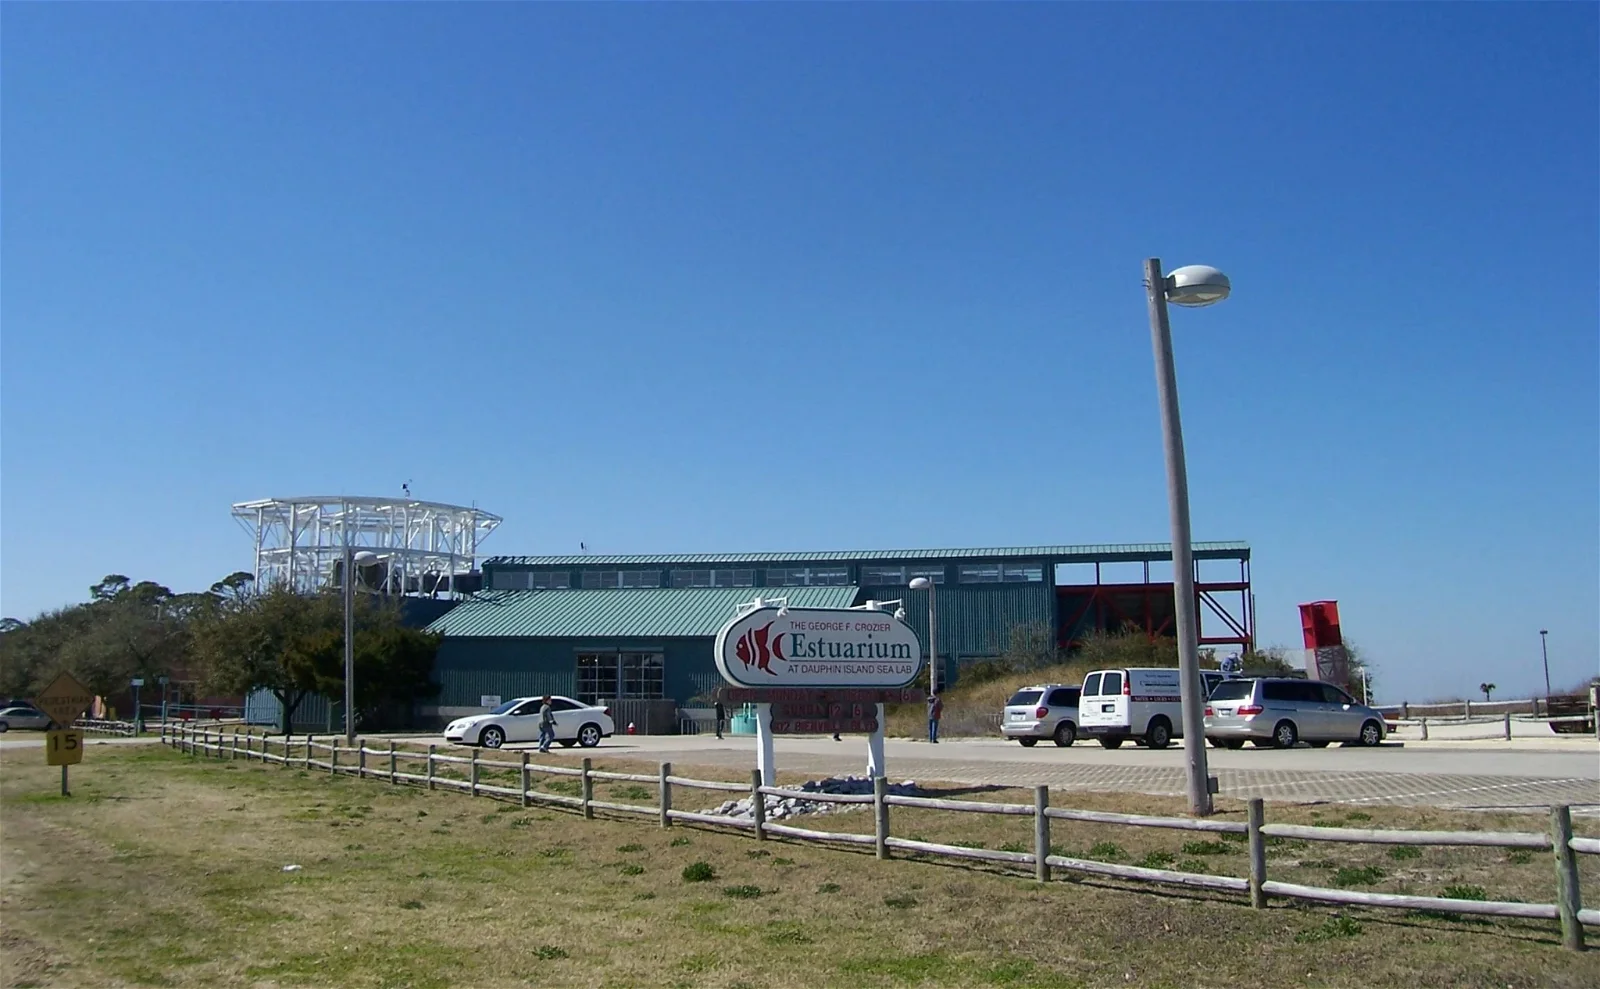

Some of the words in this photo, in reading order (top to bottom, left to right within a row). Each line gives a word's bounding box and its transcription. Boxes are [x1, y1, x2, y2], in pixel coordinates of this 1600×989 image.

[790, 621, 806, 630] THE
[808, 621, 843, 631] GEORGE
[845, 622, 853, 631] F.
[855, 623, 891, 632] CROZIER
[790, 633, 912, 659] Estuarium
[788, 664, 798, 673] AT
[801, 664, 841, 674] DAUPHIN
[843, 664, 875, 674] ISLAND
[877, 664, 894, 674] SEA
[896, 664, 912, 674] LAB
[53, 734, 77, 751] 15
